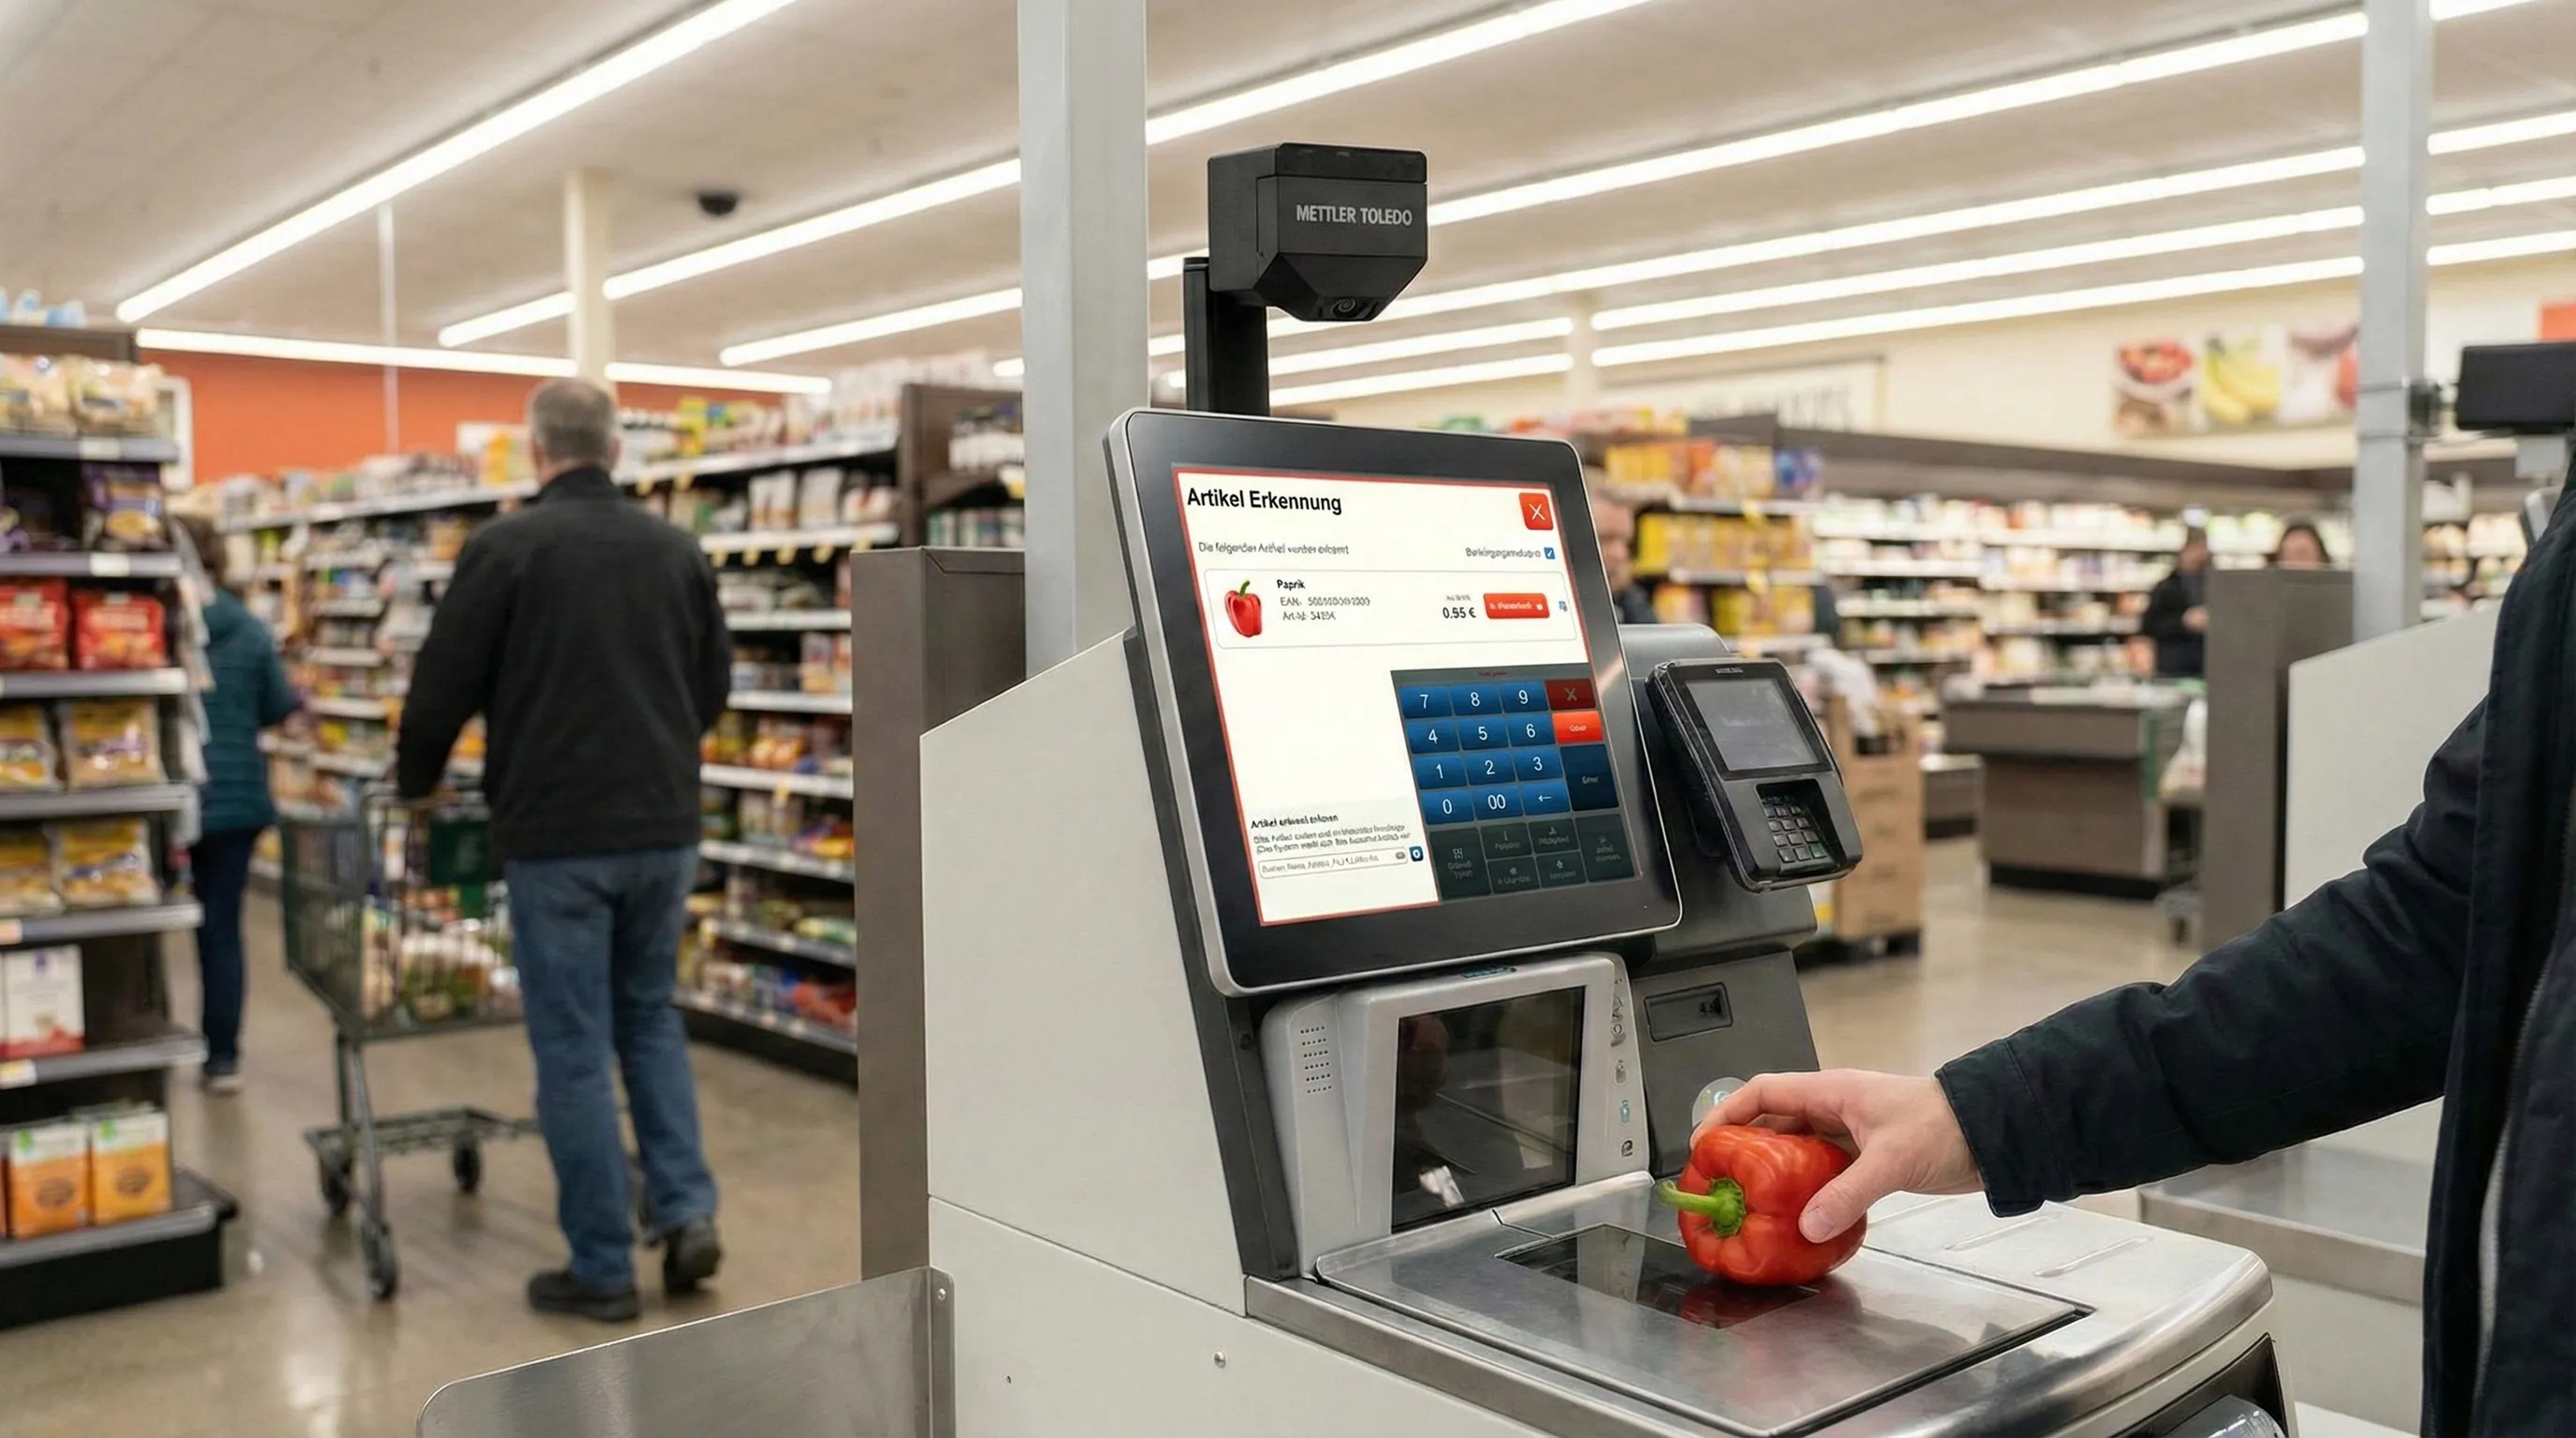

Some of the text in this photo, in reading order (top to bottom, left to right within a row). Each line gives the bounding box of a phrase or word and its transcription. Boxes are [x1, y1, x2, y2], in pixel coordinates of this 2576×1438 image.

[1296, 205, 1412, 226] METTLER TOLEDO
[1187, 487, 1342, 515] Artikel Erkennung
[1420, 690, 1528, 709] 7 8 9
[1428, 724, 1536, 744] 4 5 6
[1436, 756, 1543, 779] 1 2 3
[1442, 794, 1506, 814] 0 00
